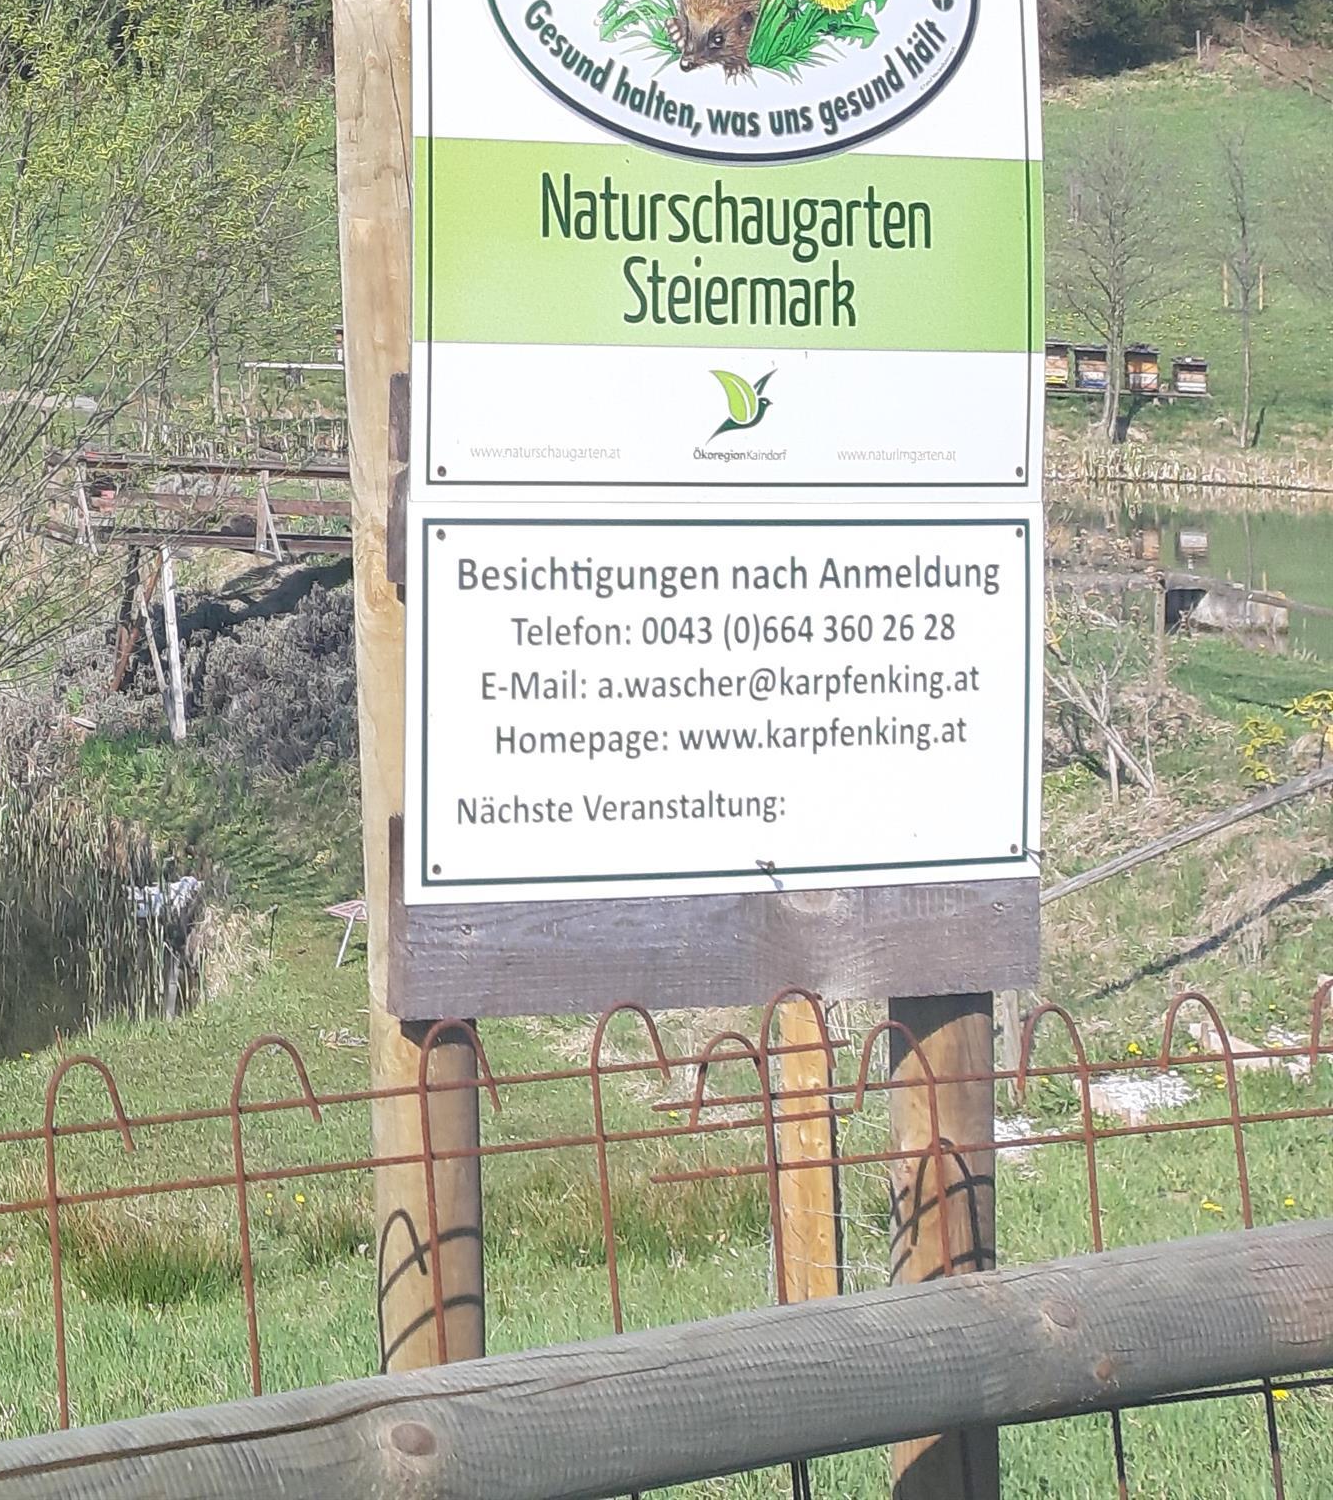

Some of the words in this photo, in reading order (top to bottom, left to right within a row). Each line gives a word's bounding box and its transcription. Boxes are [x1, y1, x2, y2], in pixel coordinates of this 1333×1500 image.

[524, 0, 614, 91] Gesund
[612, 72, 702, 134] halten,
[706, 105, 760, 137] was
[769, 104, 813, 137] uns
[819, 56, 907, 136] gesund
[895, 18, 949, 79] hält
[540, 171, 933, 263] Naturschaugarten
[622, 256, 857, 328] Steiermark
[470, 444, 621, 462] www.naturschaugarten.at
[457, 557, 720, 599] Besichtigungen
[731, 556, 808, 590] nach
[819, 554, 1001, 596] Anmeldung
[511, 615, 632, 647] Telefon:
[641, 615, 713, 646] 0043
[723, 613, 815, 652] (0)664
[823, 614, 874, 644] 360
[882, 613, 916, 643] 26
[923, 612, 956, 642] 28
[480, 670, 588, 702] E-Mail:
[598, 663, 981, 702] a.wascher@karpfenking.at
[495, 723, 670, 760] Homepage:
[678, 716, 968, 755] www.karpfenking.at
[456, 795, 574, 825] Nächste
[582, 789, 787, 824] Veranstaltung:
